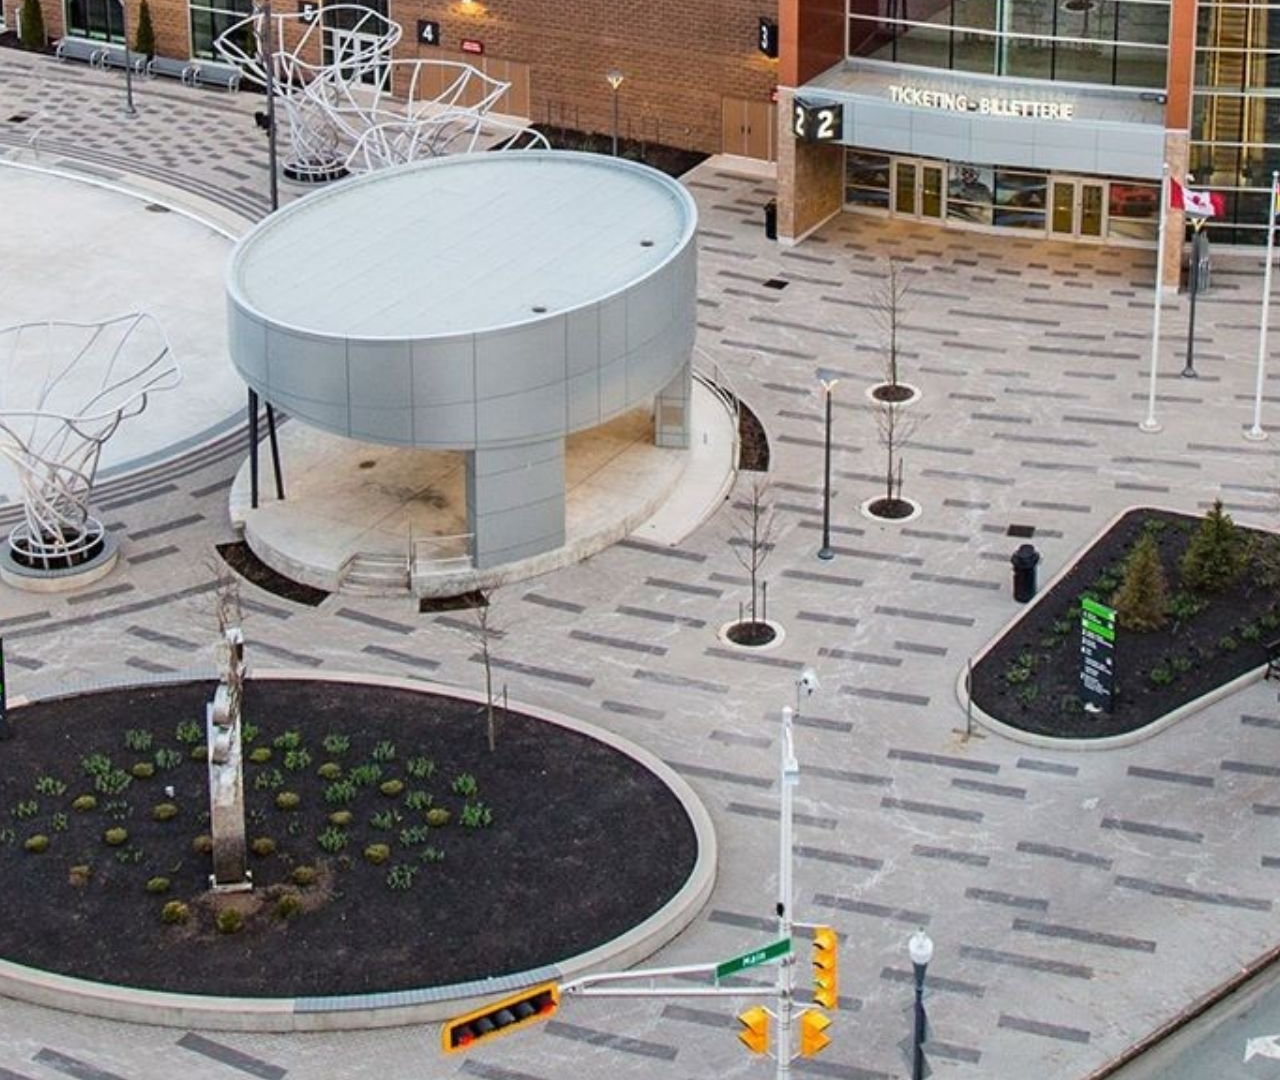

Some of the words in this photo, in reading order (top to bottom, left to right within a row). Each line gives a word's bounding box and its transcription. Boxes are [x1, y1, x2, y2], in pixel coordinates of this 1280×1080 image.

[421, 25, 434, 42] 4
[888, 85, 969, 112] TICKETING
[980, 94, 1074, 121] BILLETTERIE
[817, 110, 834, 139] 2
